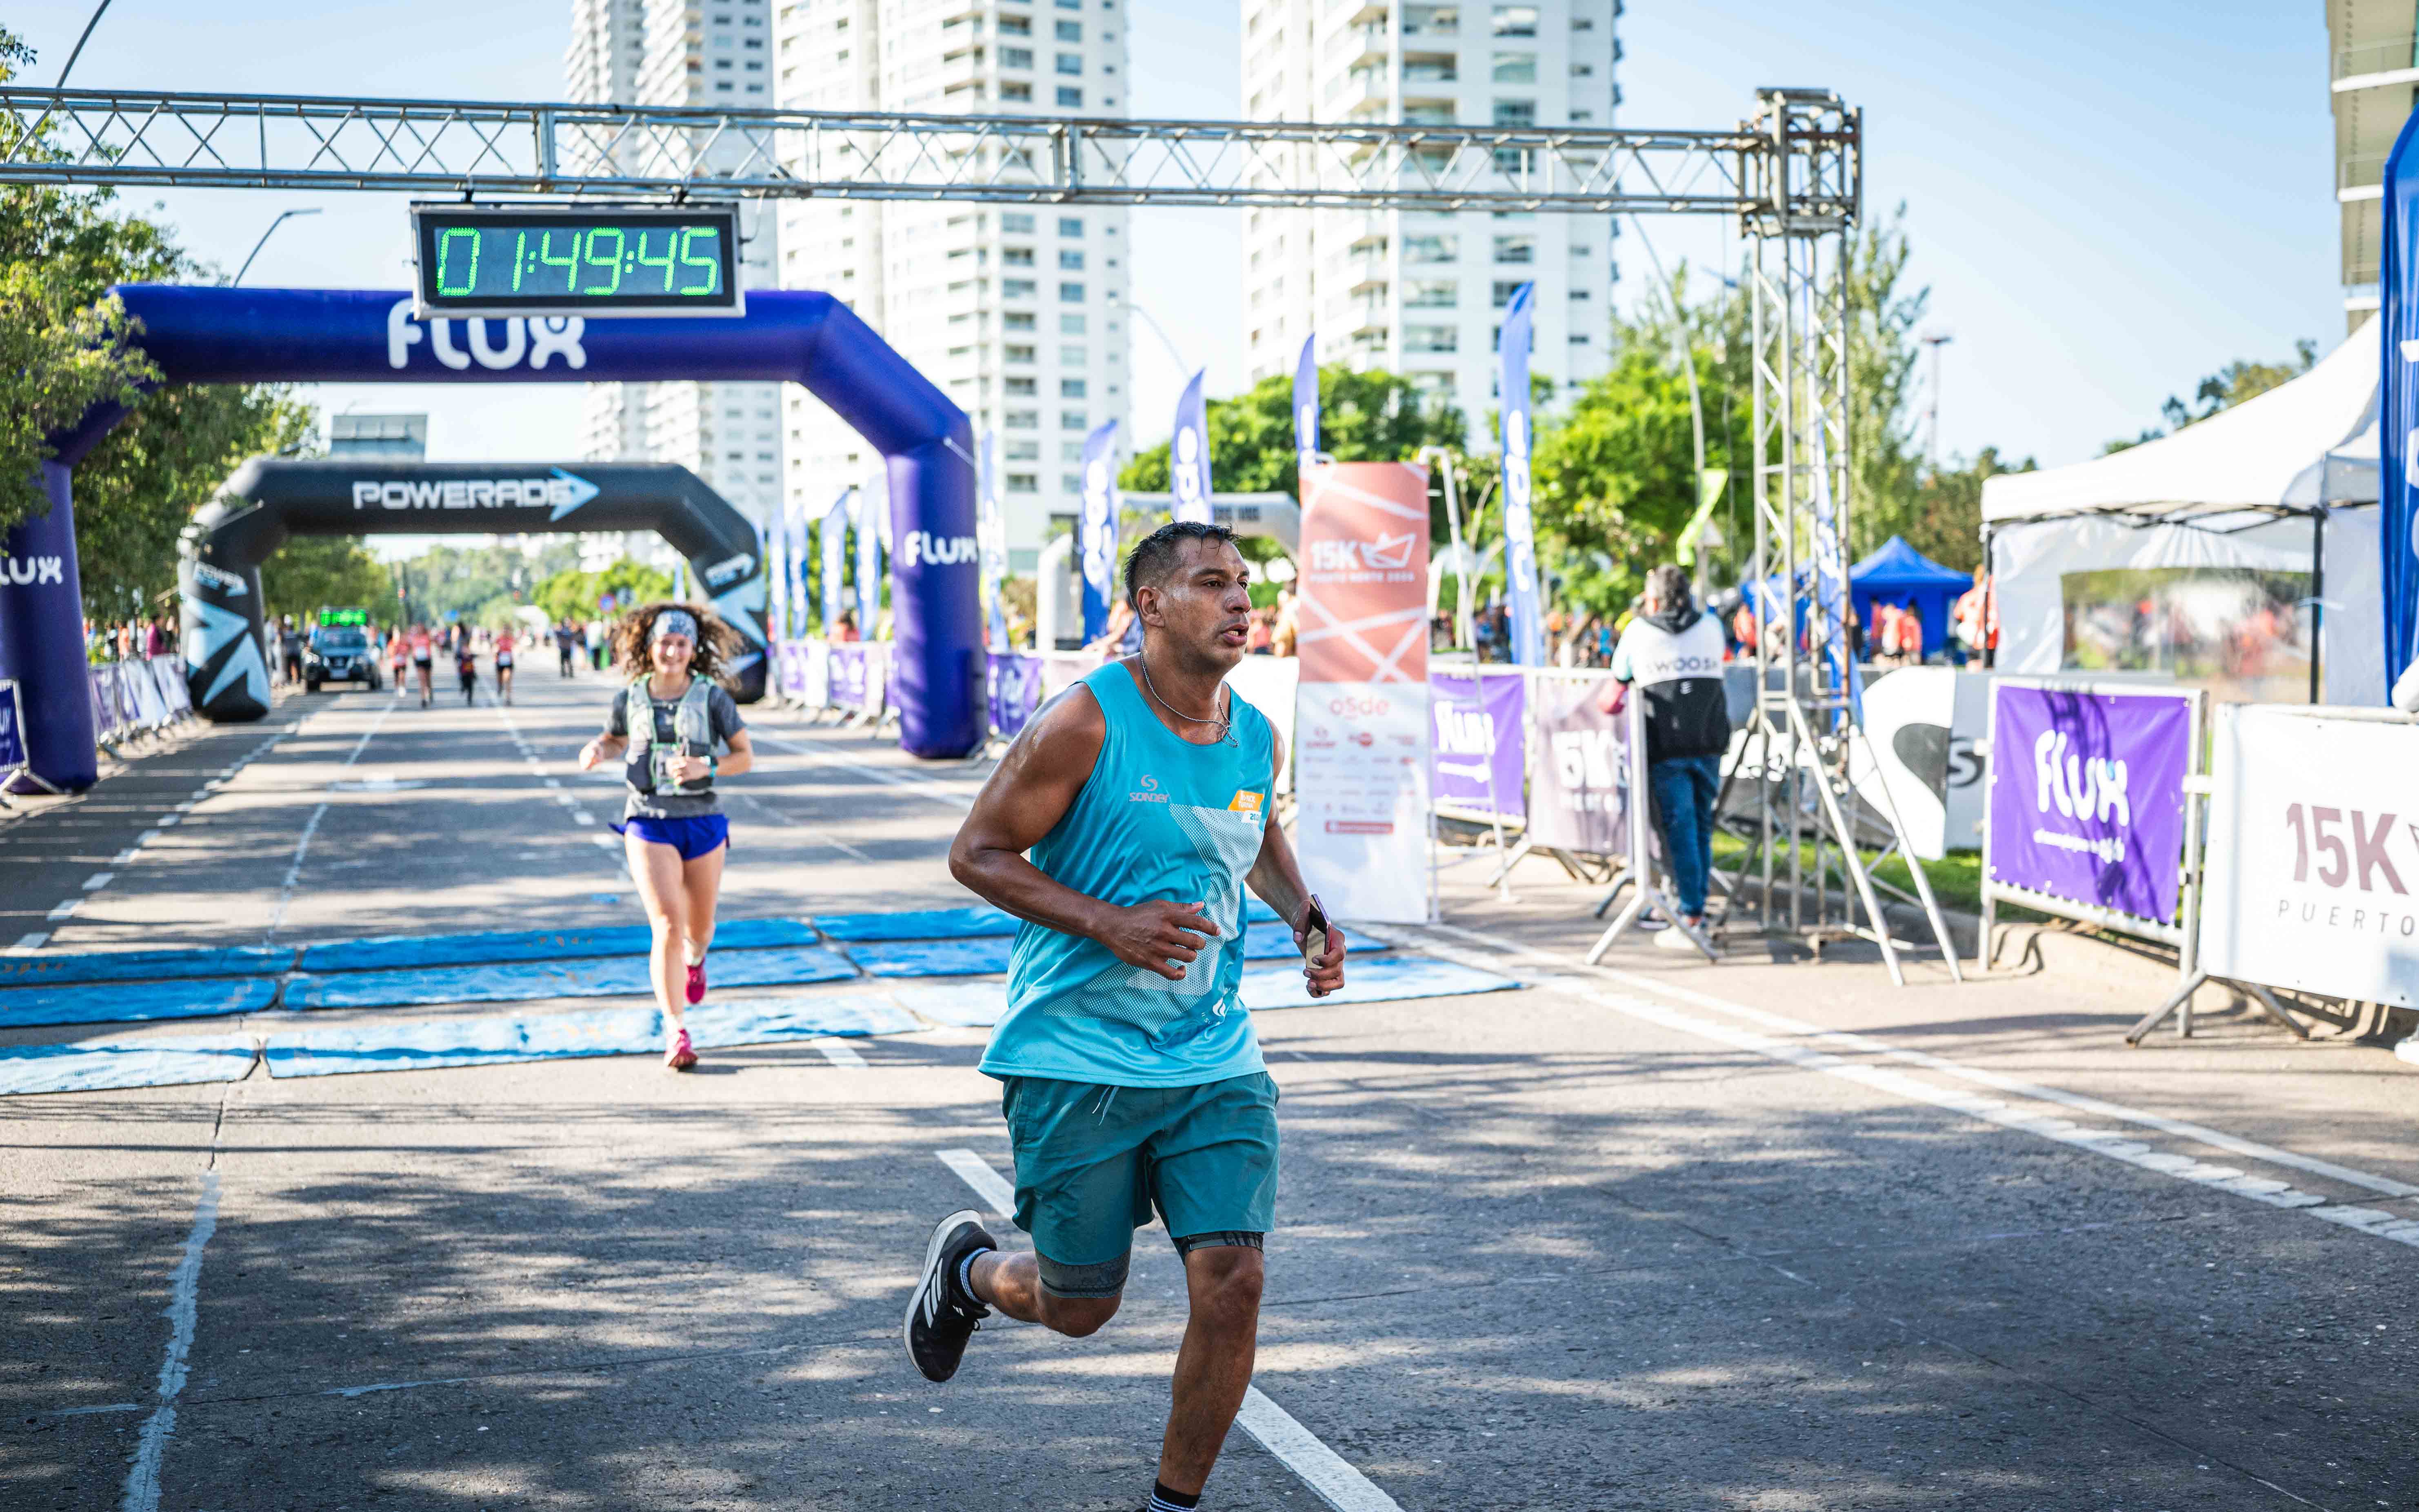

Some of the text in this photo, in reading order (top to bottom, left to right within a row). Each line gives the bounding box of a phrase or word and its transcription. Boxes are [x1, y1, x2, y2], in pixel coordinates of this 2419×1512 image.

[437, 227, 718, 296] 01:49:45
[352, 478, 572, 510] POWERADE
[1308, 540, 1359, 571] 15K
[1250, 813, 1261, 821] 202
[2286, 803, 2410, 895] 15K
[2278, 899, 2415, 936] PUERTO
